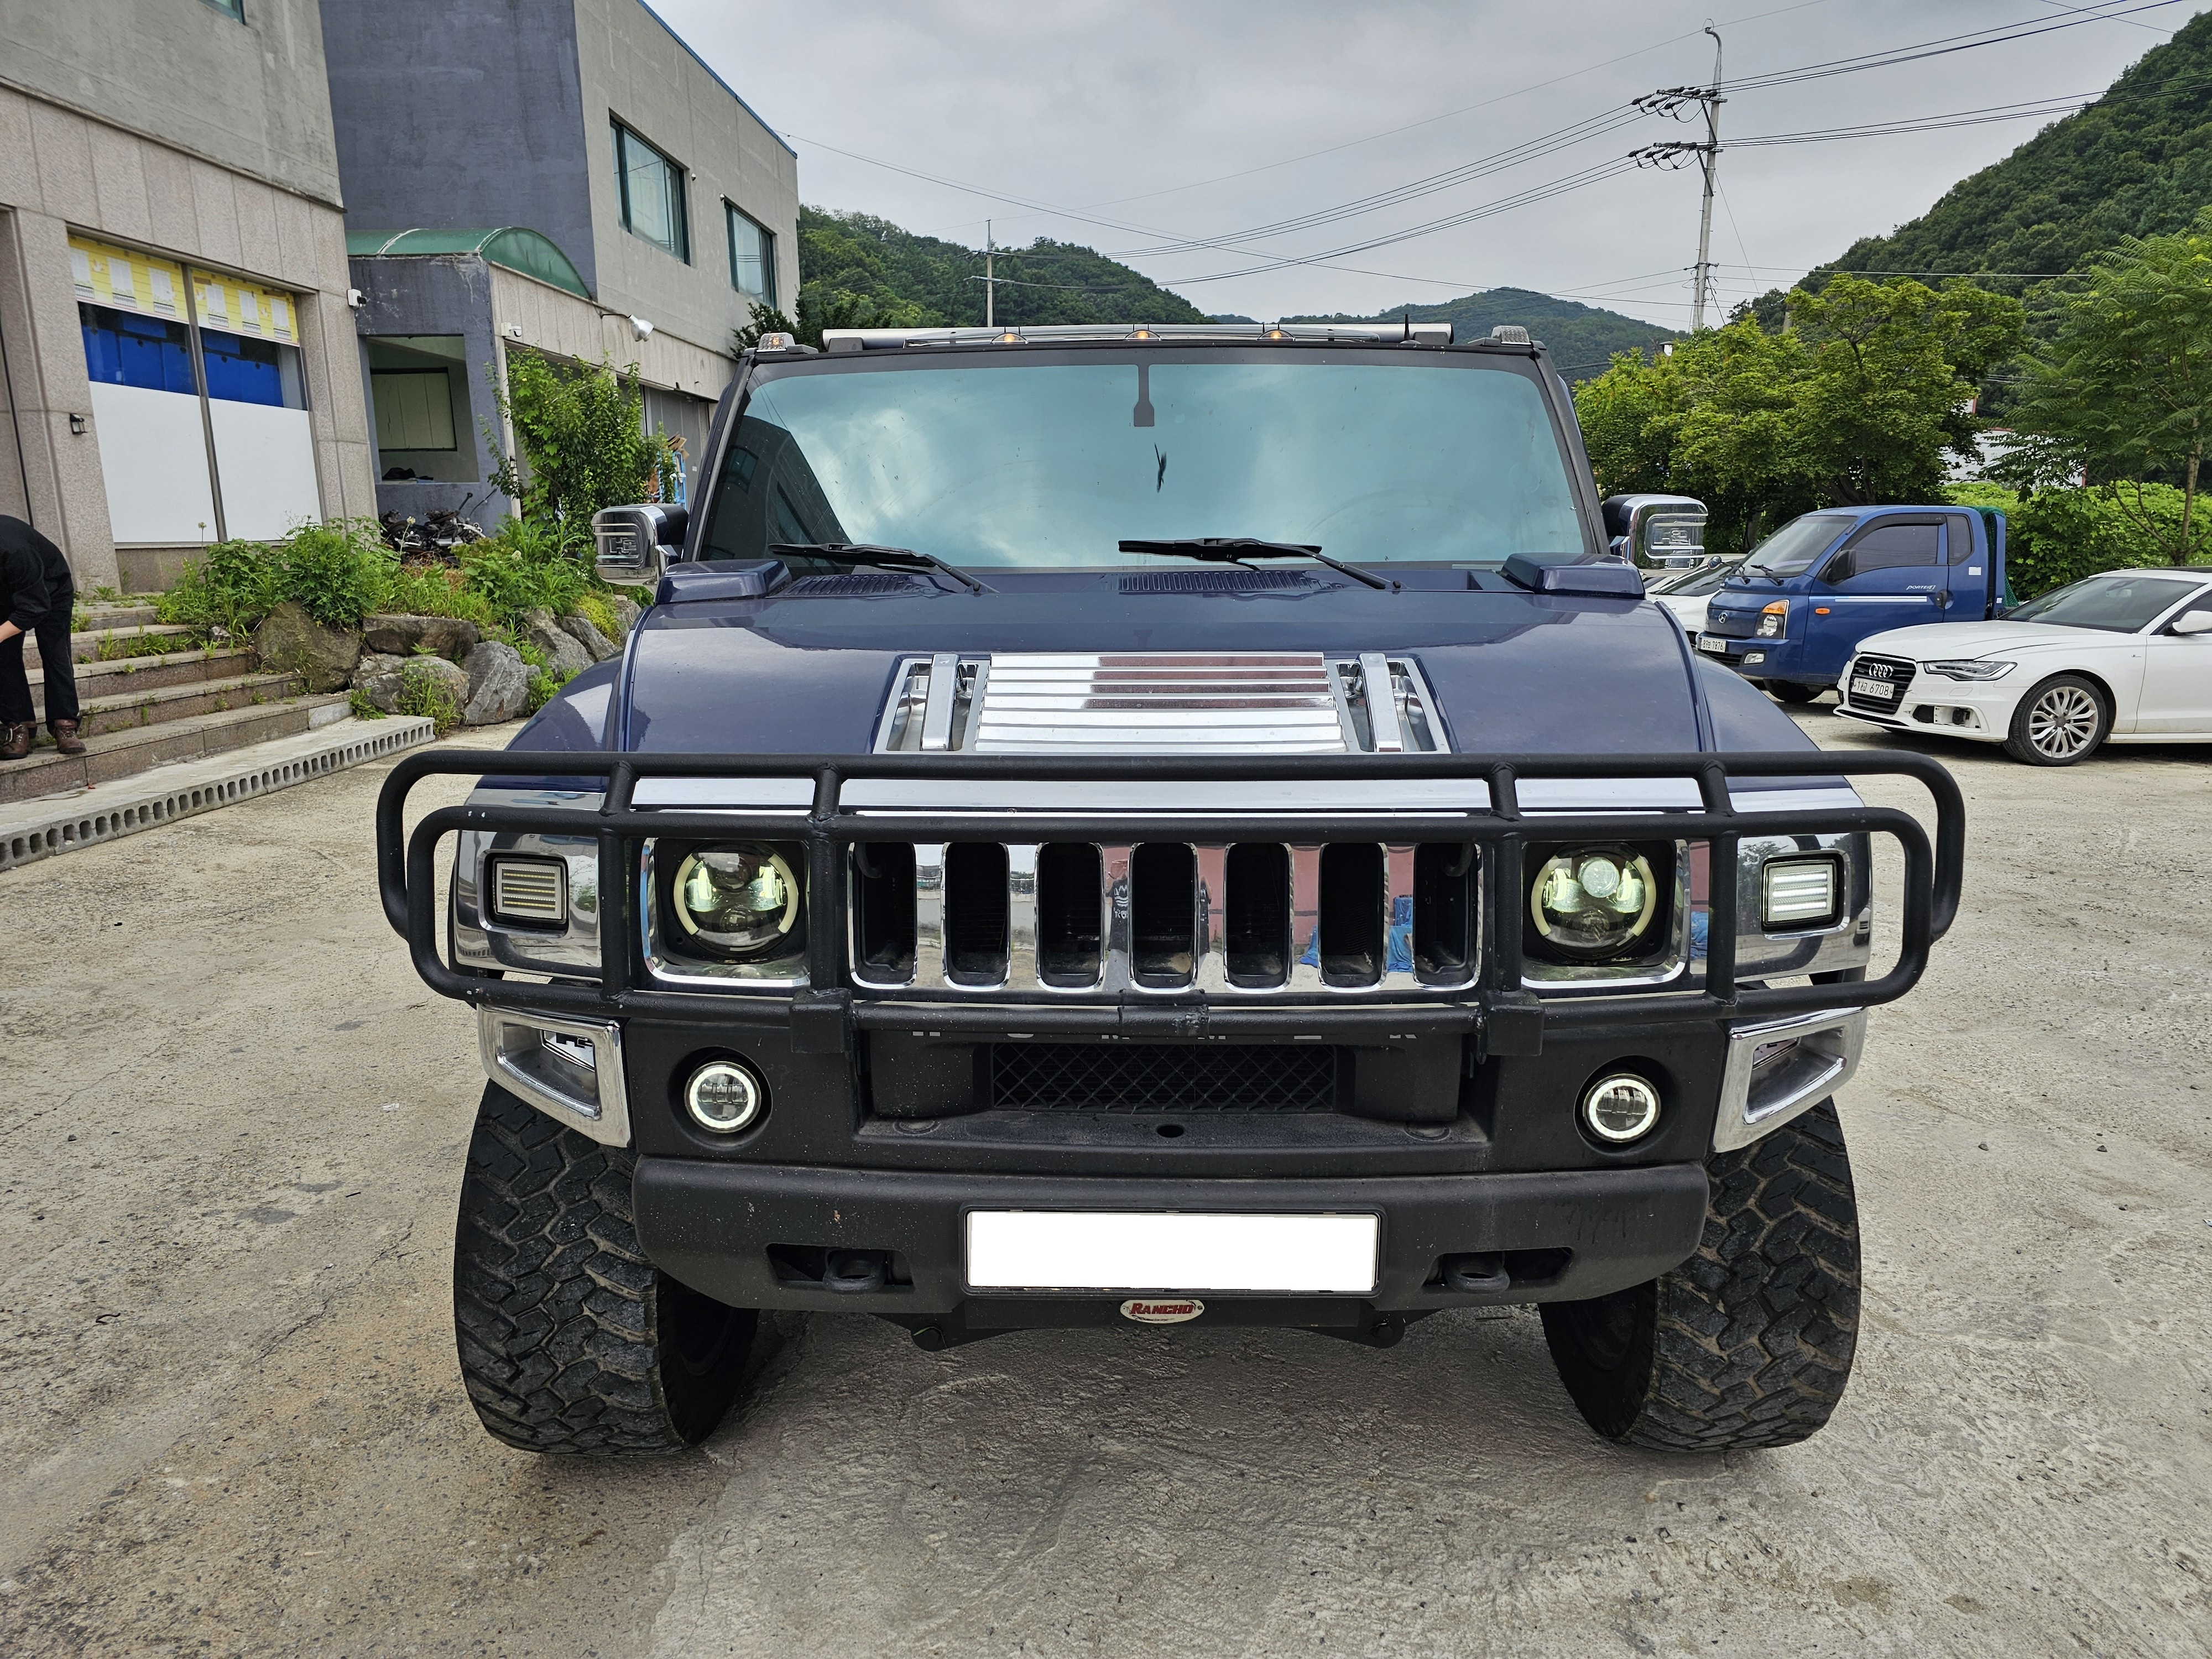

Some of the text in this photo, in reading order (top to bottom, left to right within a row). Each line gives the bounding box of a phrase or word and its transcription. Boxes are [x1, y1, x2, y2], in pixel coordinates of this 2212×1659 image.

[1712, 641, 1723, 650] 7876
[1869, 683, 1889, 696] 6708
[1130, 1303, 1194, 1314] RANCHO
